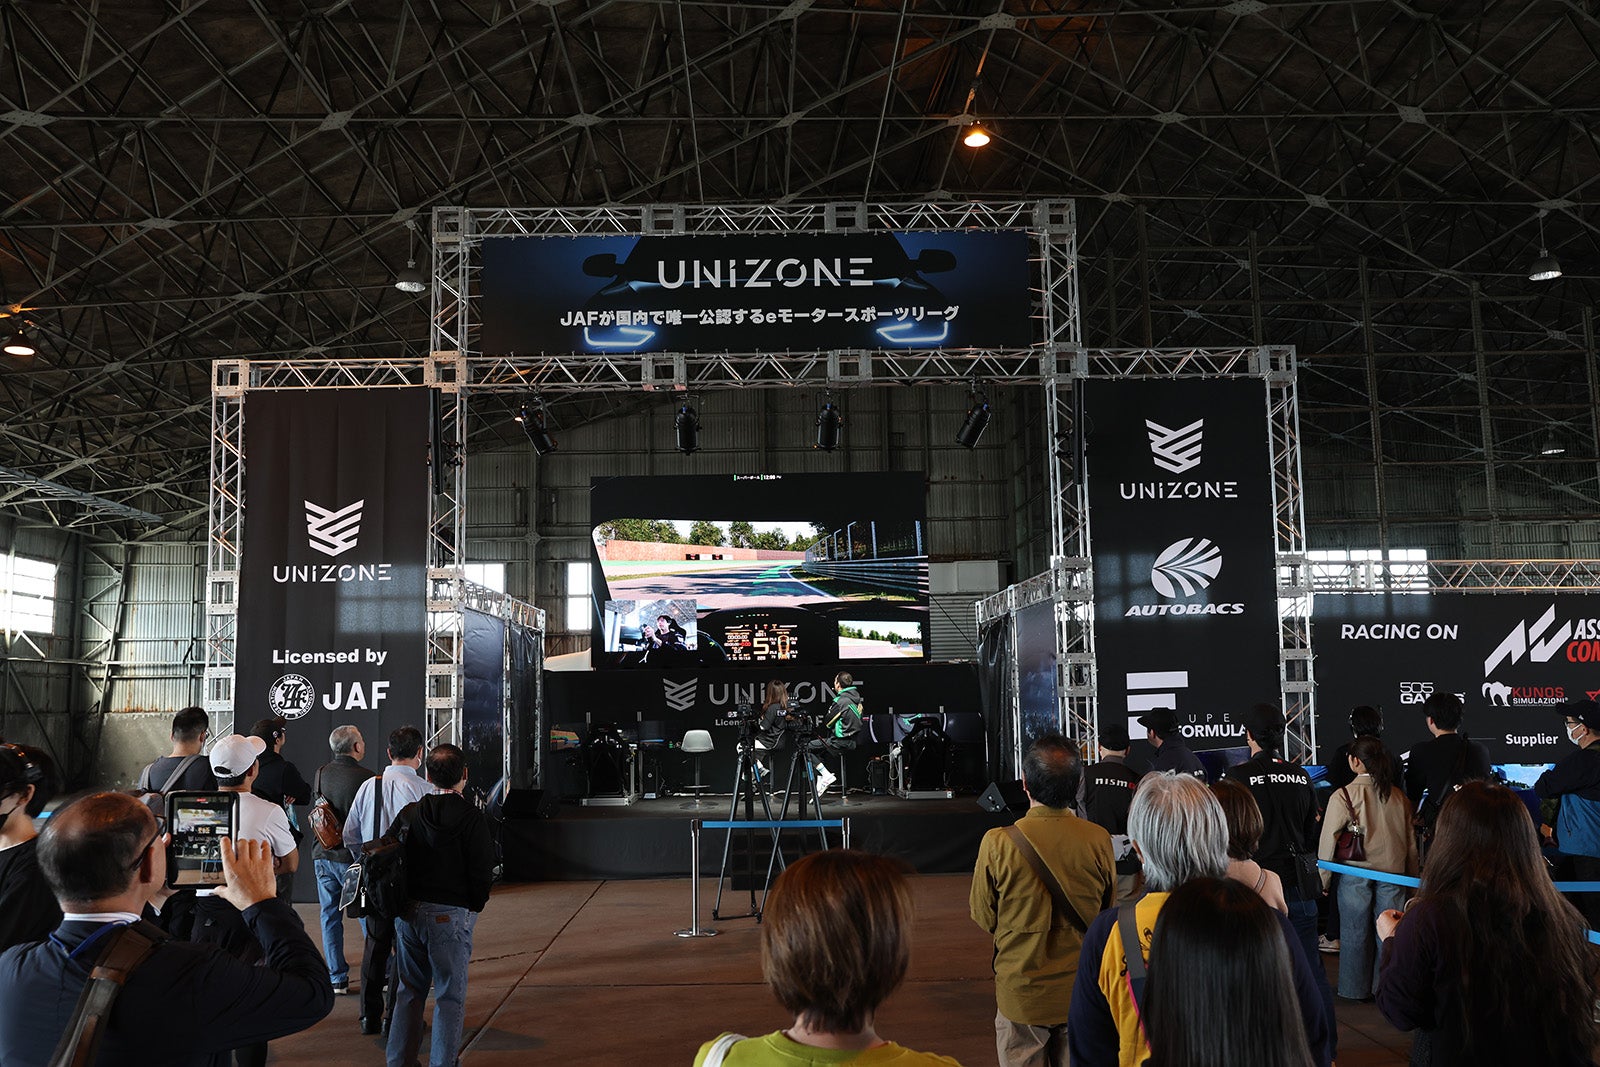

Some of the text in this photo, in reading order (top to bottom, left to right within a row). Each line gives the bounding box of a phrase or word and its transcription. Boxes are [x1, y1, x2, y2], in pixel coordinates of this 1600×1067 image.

[658, 257, 874, 289] UNIZONE
[560, 305, 960, 328] JAFが国内で唯一公認するeモータースポーツリーグ
[1120, 481, 1238, 500] UNIZONE
[273, 563, 392, 583] UNIZONE
[1124, 603, 1245, 617] AUTOBACS
[1341, 623, 1459, 640] RACING ON
[272, 648, 387, 666] Licensed by
[322, 680, 391, 711] JAF
[1400, 682, 1434, 693] 505
[1512, 687, 1565, 698] KUNOS
[1505, 732, 1559, 747] Supplier
